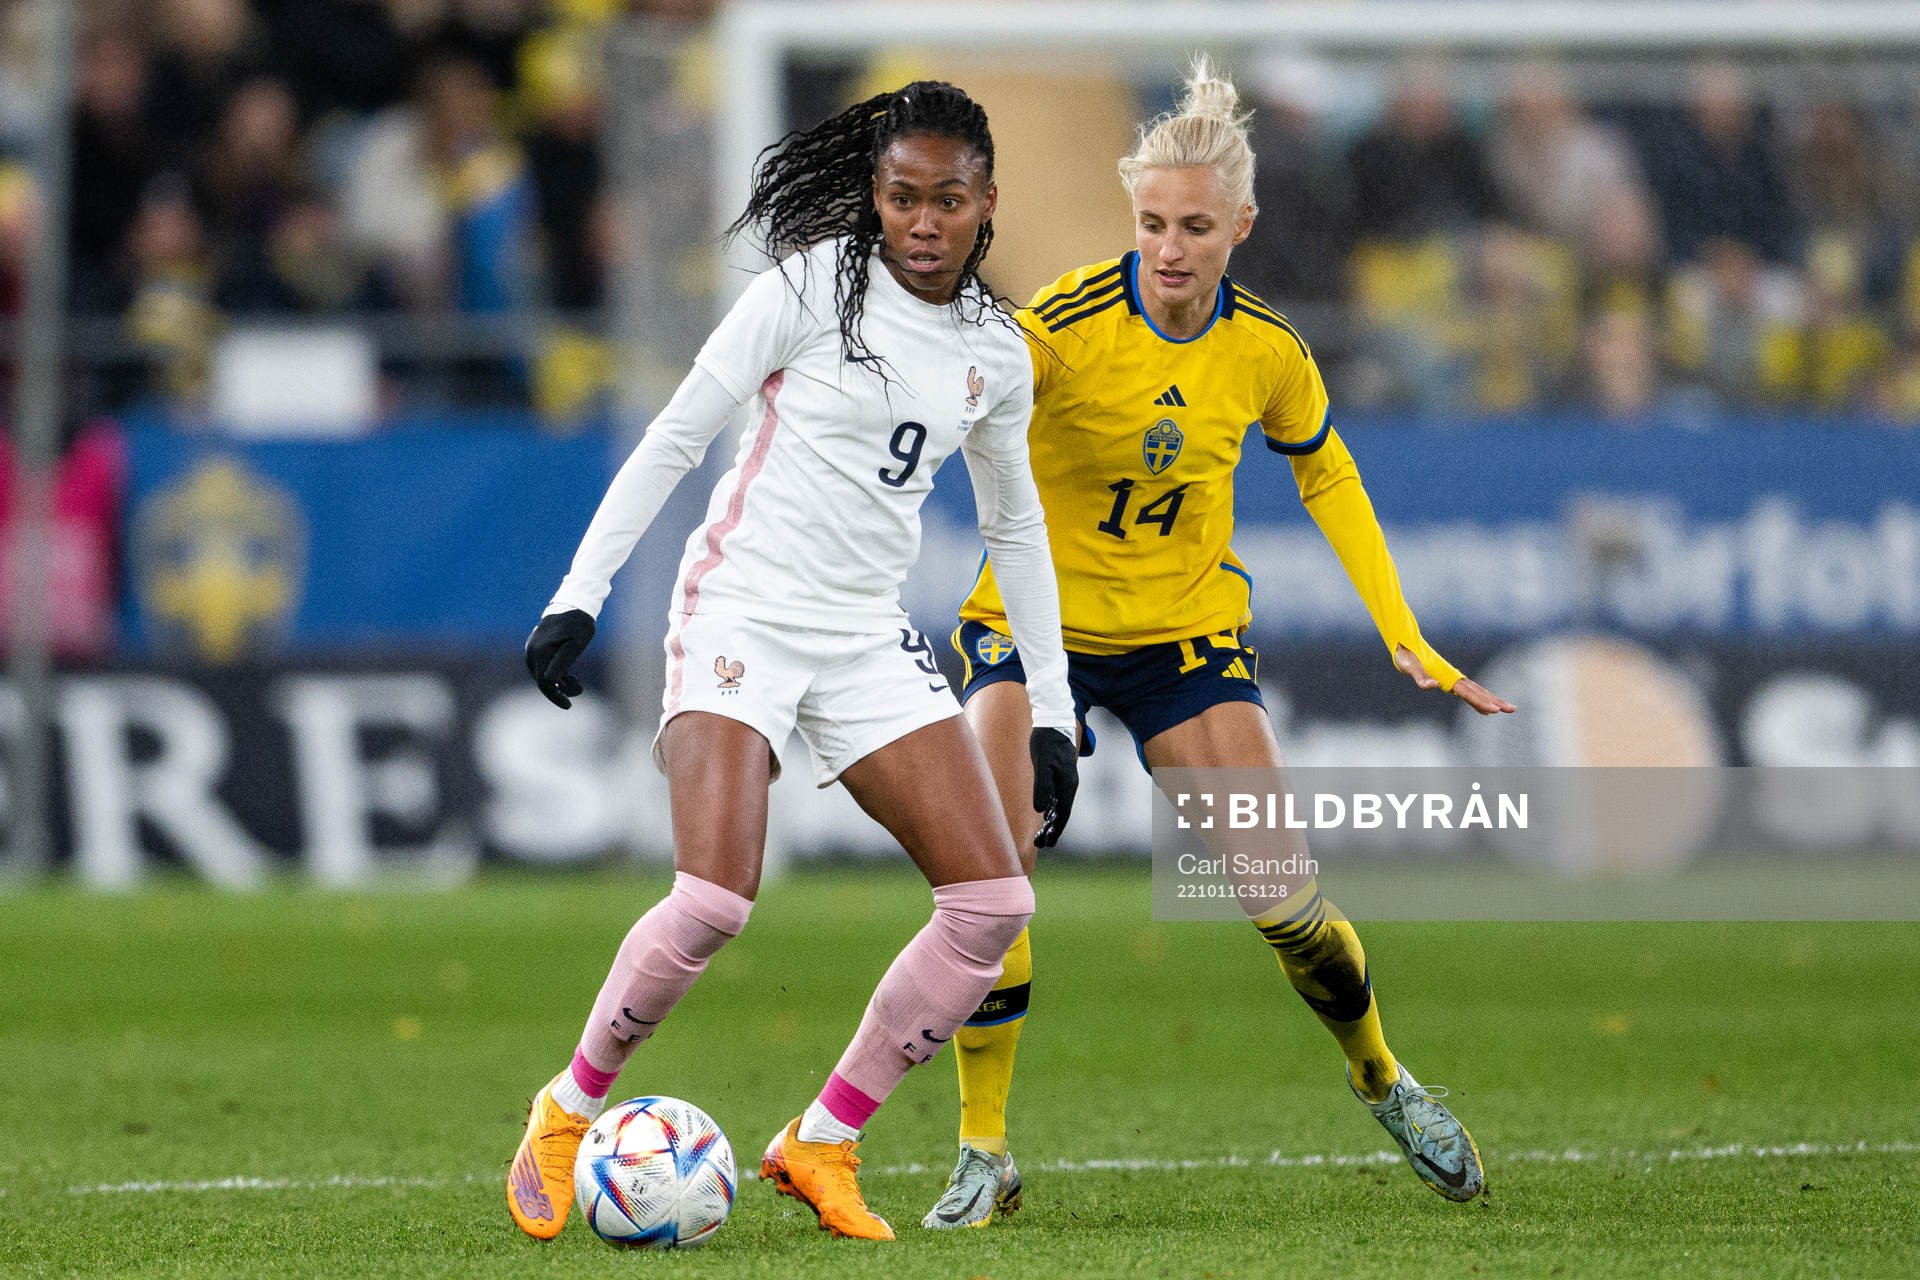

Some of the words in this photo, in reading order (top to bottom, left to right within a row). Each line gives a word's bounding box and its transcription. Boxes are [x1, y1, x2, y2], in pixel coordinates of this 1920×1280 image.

[879, 421, 927, 488] 9
[1097, 478, 1190, 540] 14
[976, 1000, 1006, 1012] GE
